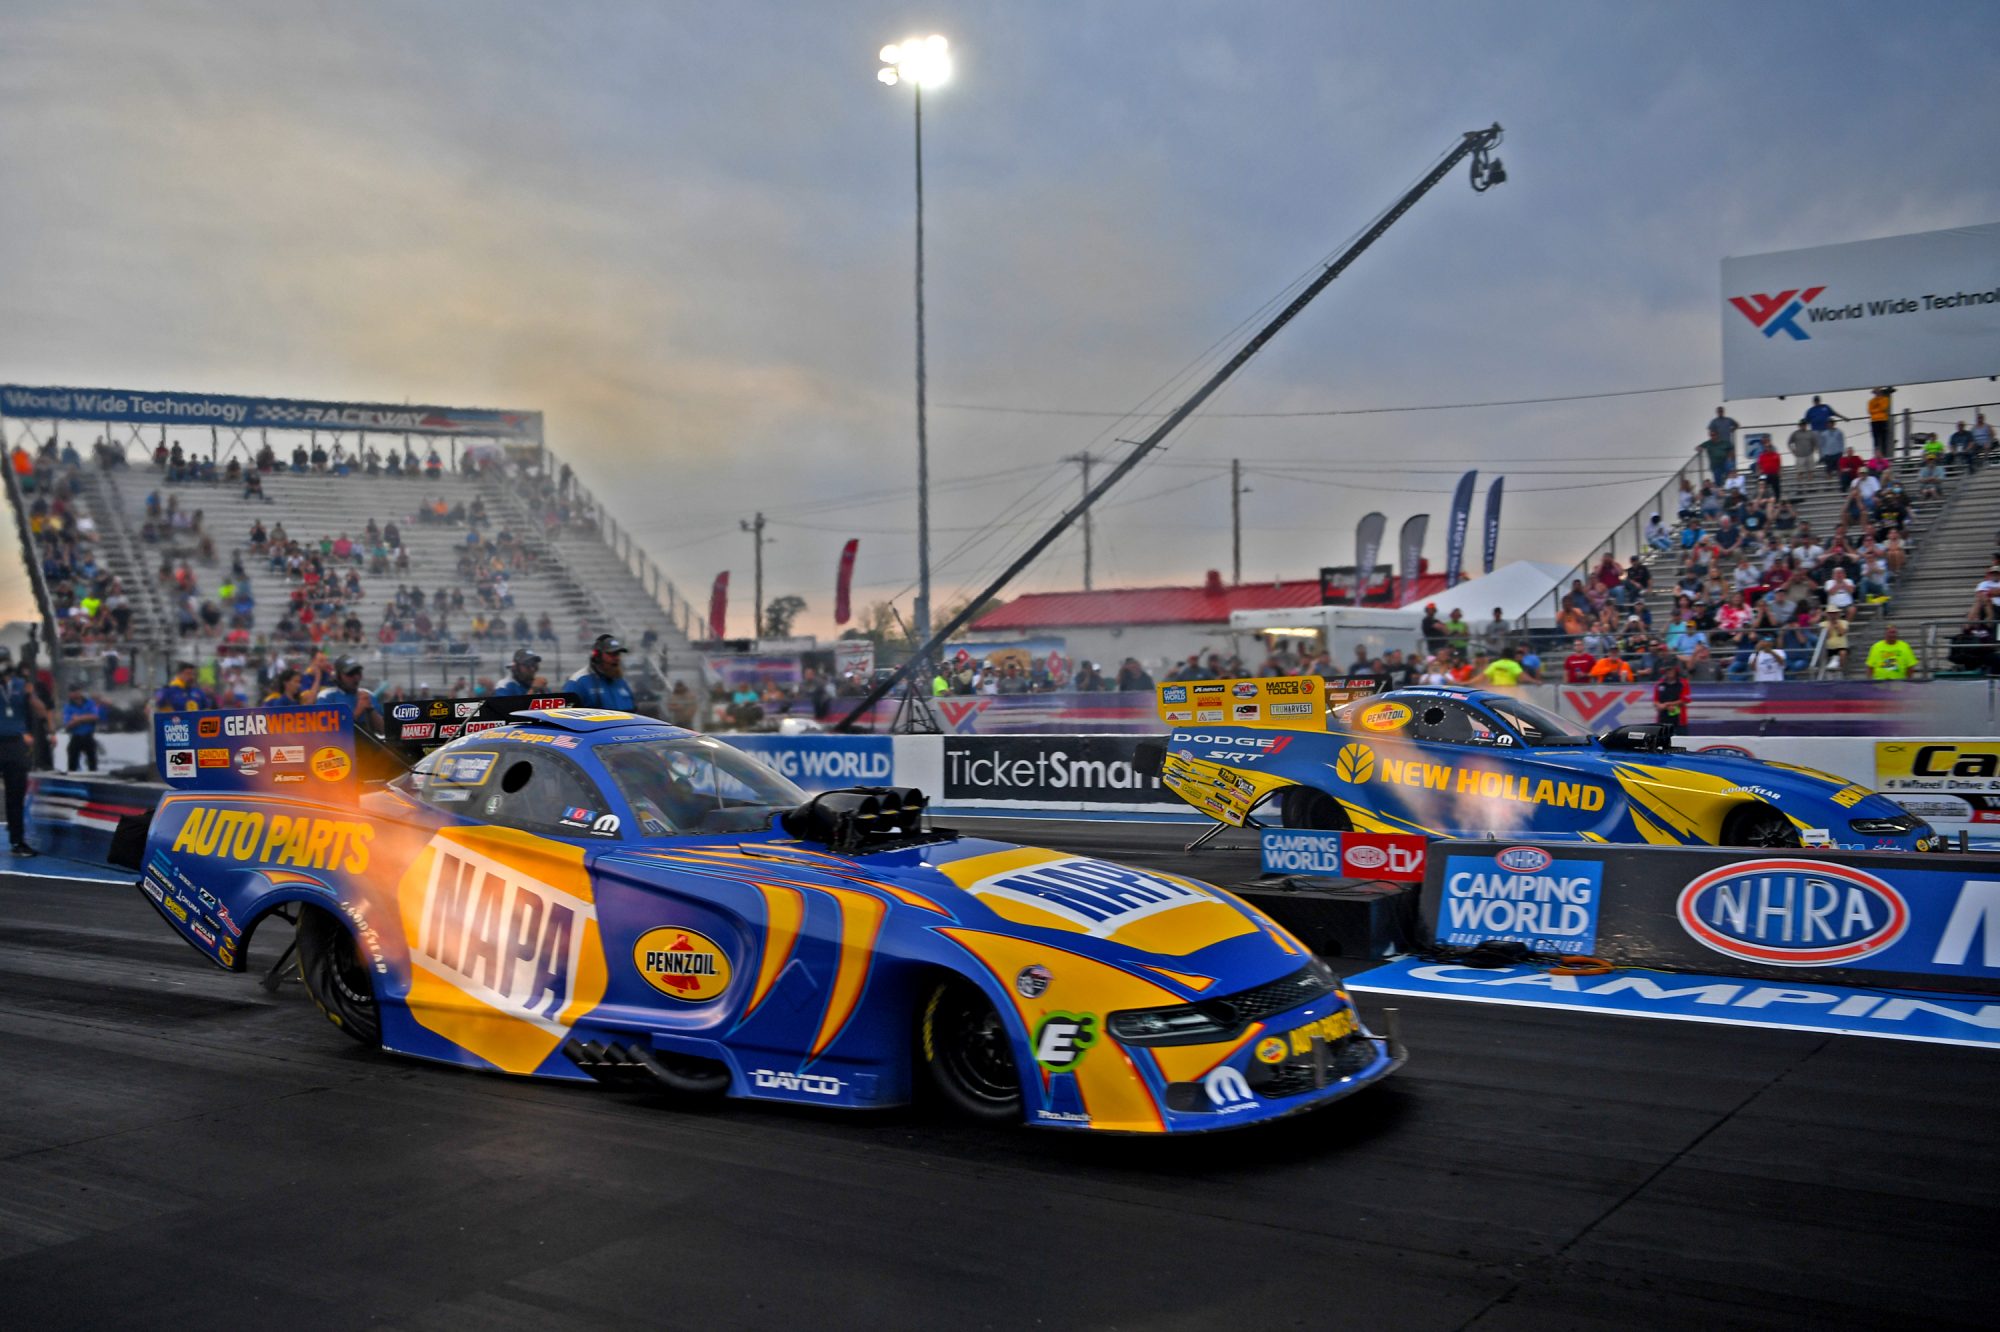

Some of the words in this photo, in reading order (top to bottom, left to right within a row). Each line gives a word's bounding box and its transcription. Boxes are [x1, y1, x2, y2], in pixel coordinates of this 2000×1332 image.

[1808, 304, 1862, 323] World
[1869, 297, 1919, 317] Wide
[4, 389, 71, 412] World
[73, 392, 128, 413] Wide
[130, 396, 249, 422] Technology
[303, 408, 428, 428] RACEWAY
[1266, 681, 1298, 690] MATCO
[392, 705, 420, 718] CLEVITE
[530, 699, 565, 710] ARP
[1271, 705, 1311, 714] TRUHARVEST
[224, 710, 340, 737] GEARWRENCH
[1367, 710, 1404, 723] PENNZOIL
[165, 732, 189, 742] WORLD
[401, 724, 431, 737] MANLEY
[507, 730, 555, 744] Capps
[1173, 733, 1276, 748] DODGE
[801, 751, 891, 778] WORLD
[1204, 750, 1265, 763] SRT
[1381, 758, 1452, 790] NEW
[1457, 768, 1605, 812] HOLLAND
[1721, 785, 1782, 800] GOODYEAR
[1885, 780, 1896, 788] 4
[1900, 779, 1942, 789] Wheel
[1947, 779, 1985, 790] Drive
[171, 807, 266, 862] AUTO
[259, 815, 376, 875] PARTS
[1263, 834, 1337, 853] CAMPING
[1266, 850, 1339, 872] WORLD
[1502, 850, 1544, 869] NHRA
[991, 860, 1206, 923] NAPA
[1448, 871, 1592, 905] CAMPING
[1448, 897, 1590, 937] WORLD
[1712, 876, 1875, 943] NHRA
[426, 852, 575, 1022] NAPA
[646, 950, 718, 976] PENNZOIL
[755, 1069, 840, 1096] DAYCO
